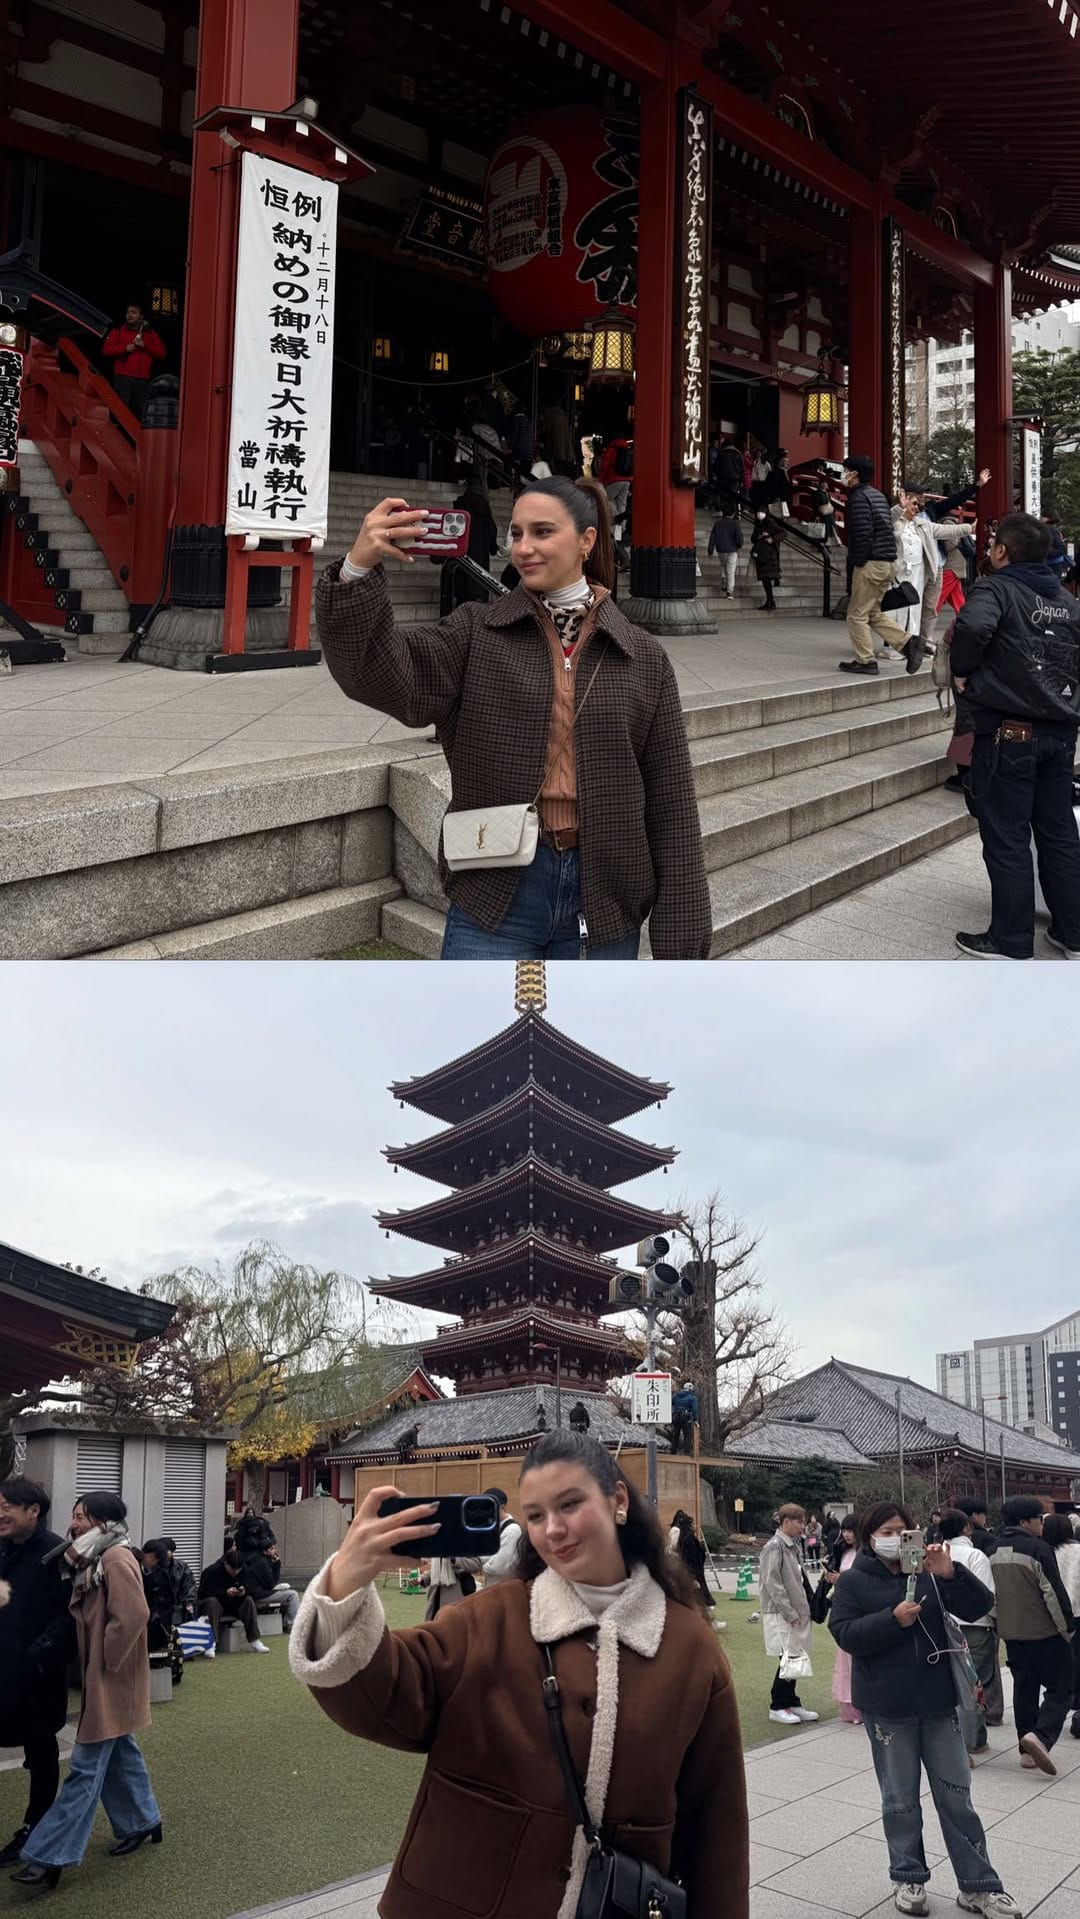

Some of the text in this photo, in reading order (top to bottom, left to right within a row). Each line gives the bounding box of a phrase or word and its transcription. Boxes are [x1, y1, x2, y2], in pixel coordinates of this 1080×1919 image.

[260, 178, 322, 223] 恒例
[314, 241, 331, 345] 十二月十八日
[237, 440, 260, 510] 當山
[1031, 595, 1070, 624] Japan
[646, 1379, 660, 1422] 朱印所
